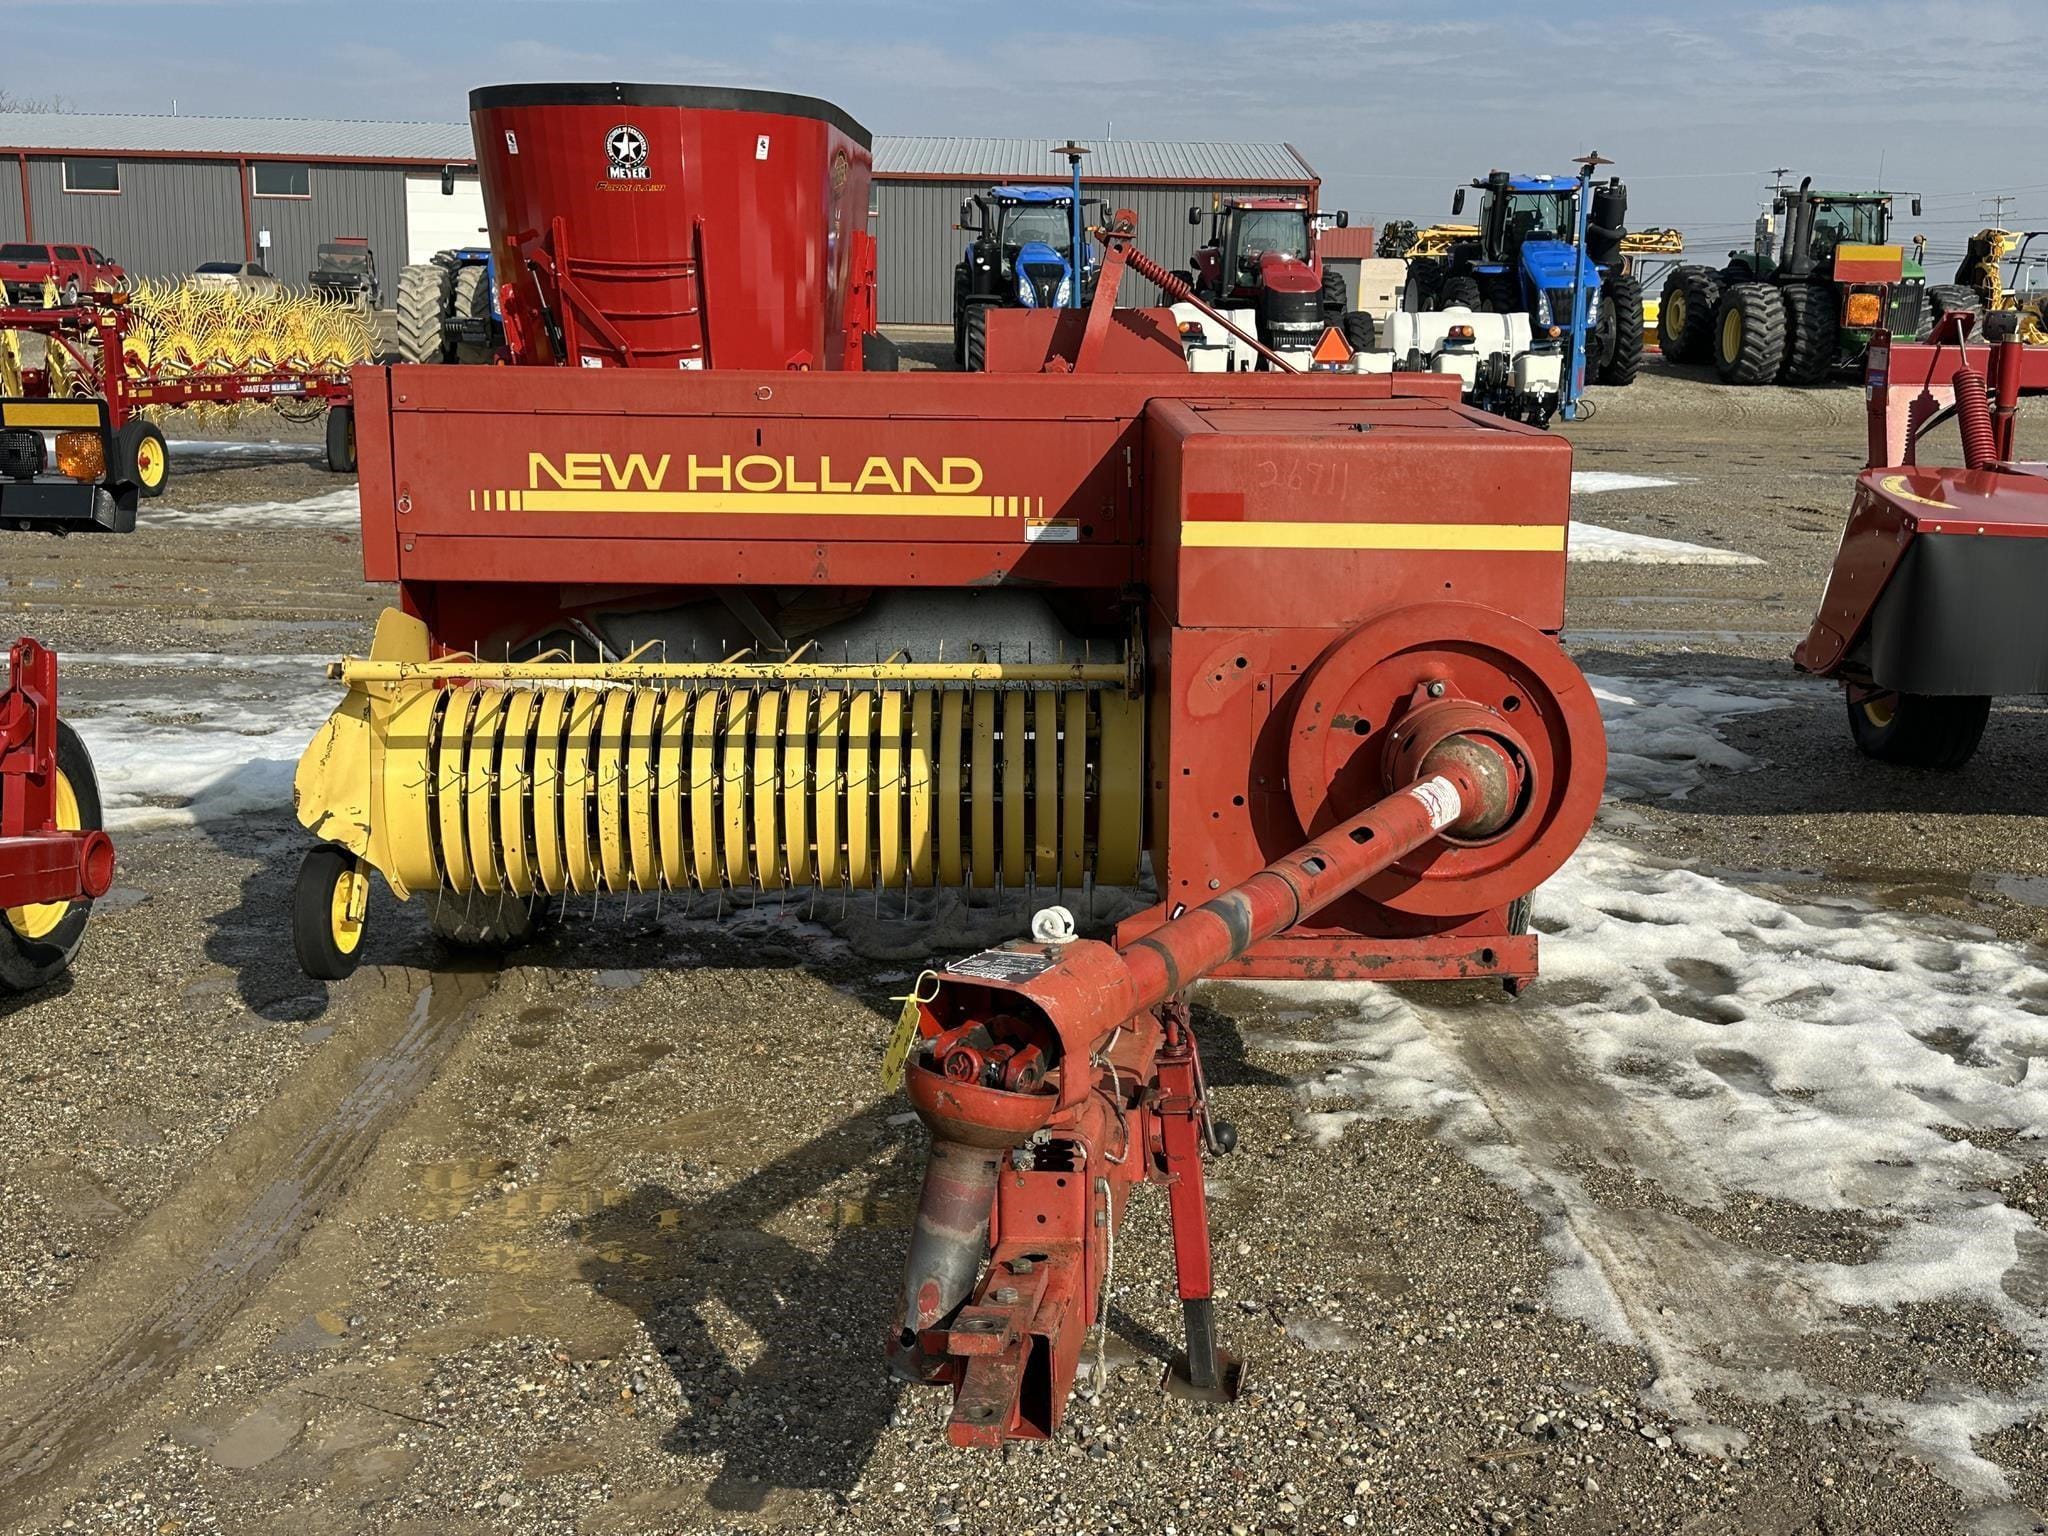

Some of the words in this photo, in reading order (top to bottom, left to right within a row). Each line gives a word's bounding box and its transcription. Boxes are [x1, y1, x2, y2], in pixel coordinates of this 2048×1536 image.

[609, 166, 646, 179] MEYER
[529, 452, 671, 490] NEW
[688, 455, 984, 493] HOLLAND
